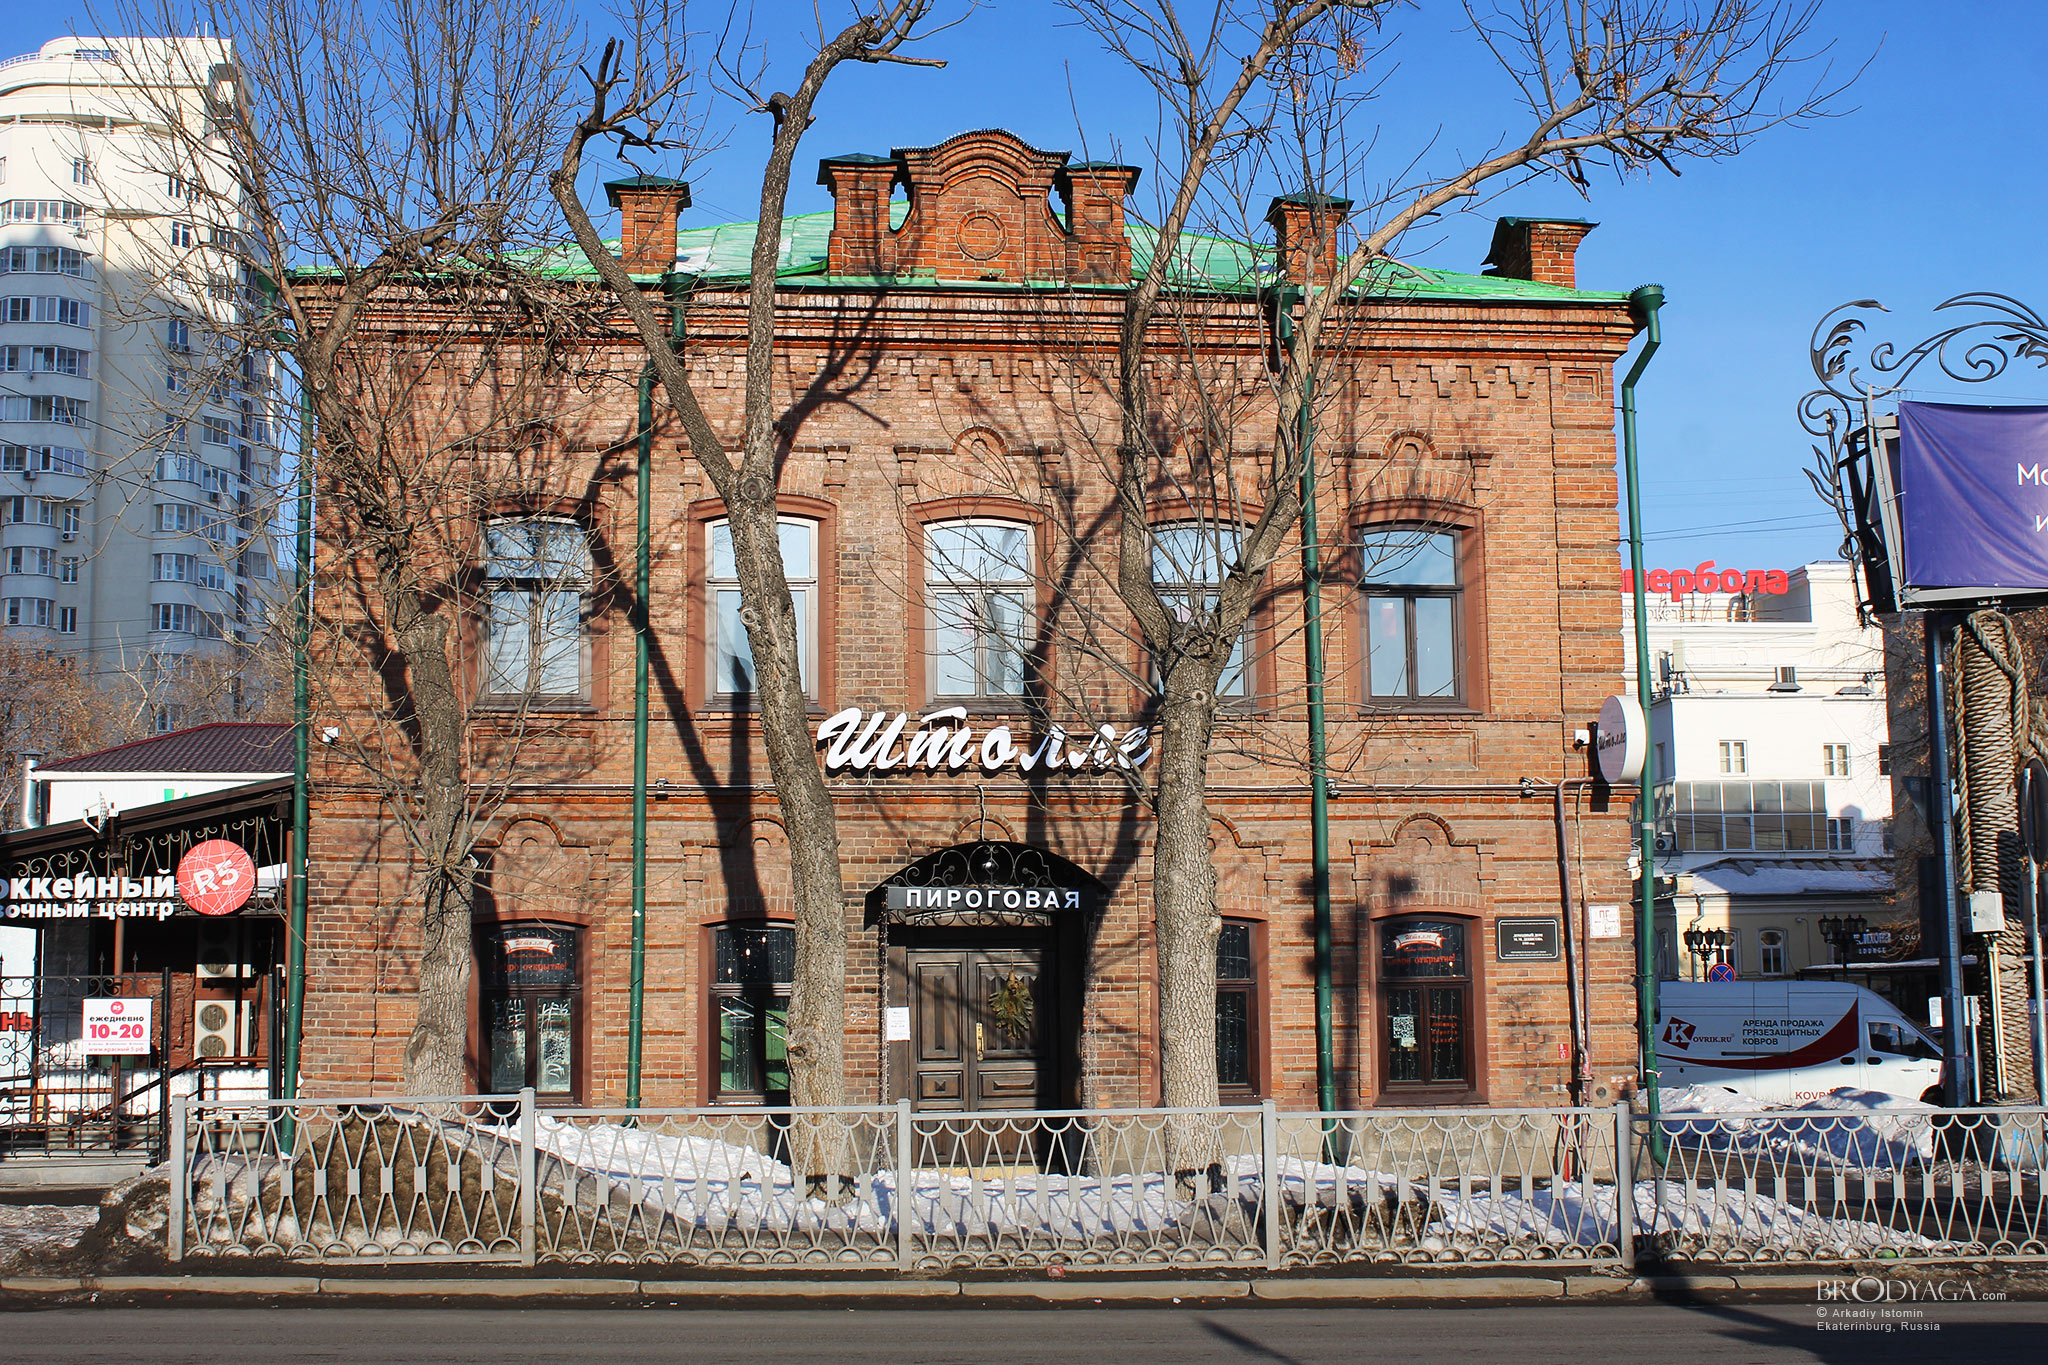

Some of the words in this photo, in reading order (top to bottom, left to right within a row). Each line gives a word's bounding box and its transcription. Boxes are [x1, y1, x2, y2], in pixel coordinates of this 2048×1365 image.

[1618, 560, 1789, 602] пербола
[816, 707, 1153, 771] Штолле
[192, 859, 241, 896] R5
[906, 890, 1080, 908] ПИРОГОВАЯ
[99, 902, 175, 921] центр
[89, 1024, 144, 1039] 10-20
[1742, 1029, 1820, 1037] ГРЯЗЕЗАЩИТНЫХ
